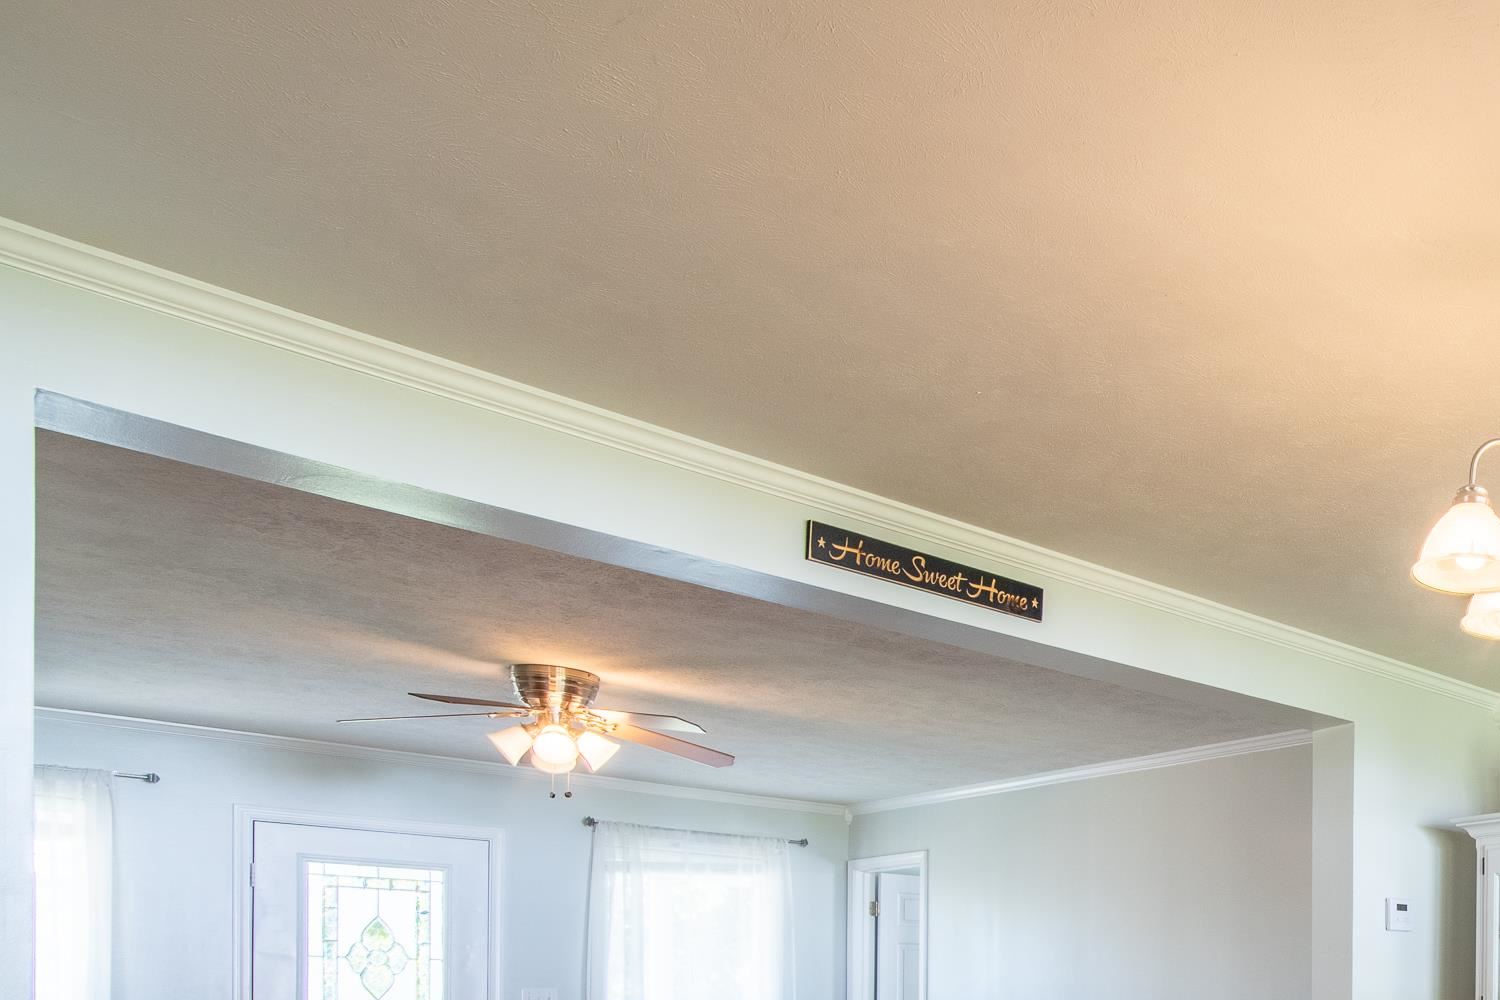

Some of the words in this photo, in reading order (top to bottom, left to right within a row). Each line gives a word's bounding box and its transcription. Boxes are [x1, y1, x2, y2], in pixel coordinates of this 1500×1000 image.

[829, 537, 901, 575] Home
[902, 556, 968, 593] Sweet
[966, 576, 1028, 611] Home
